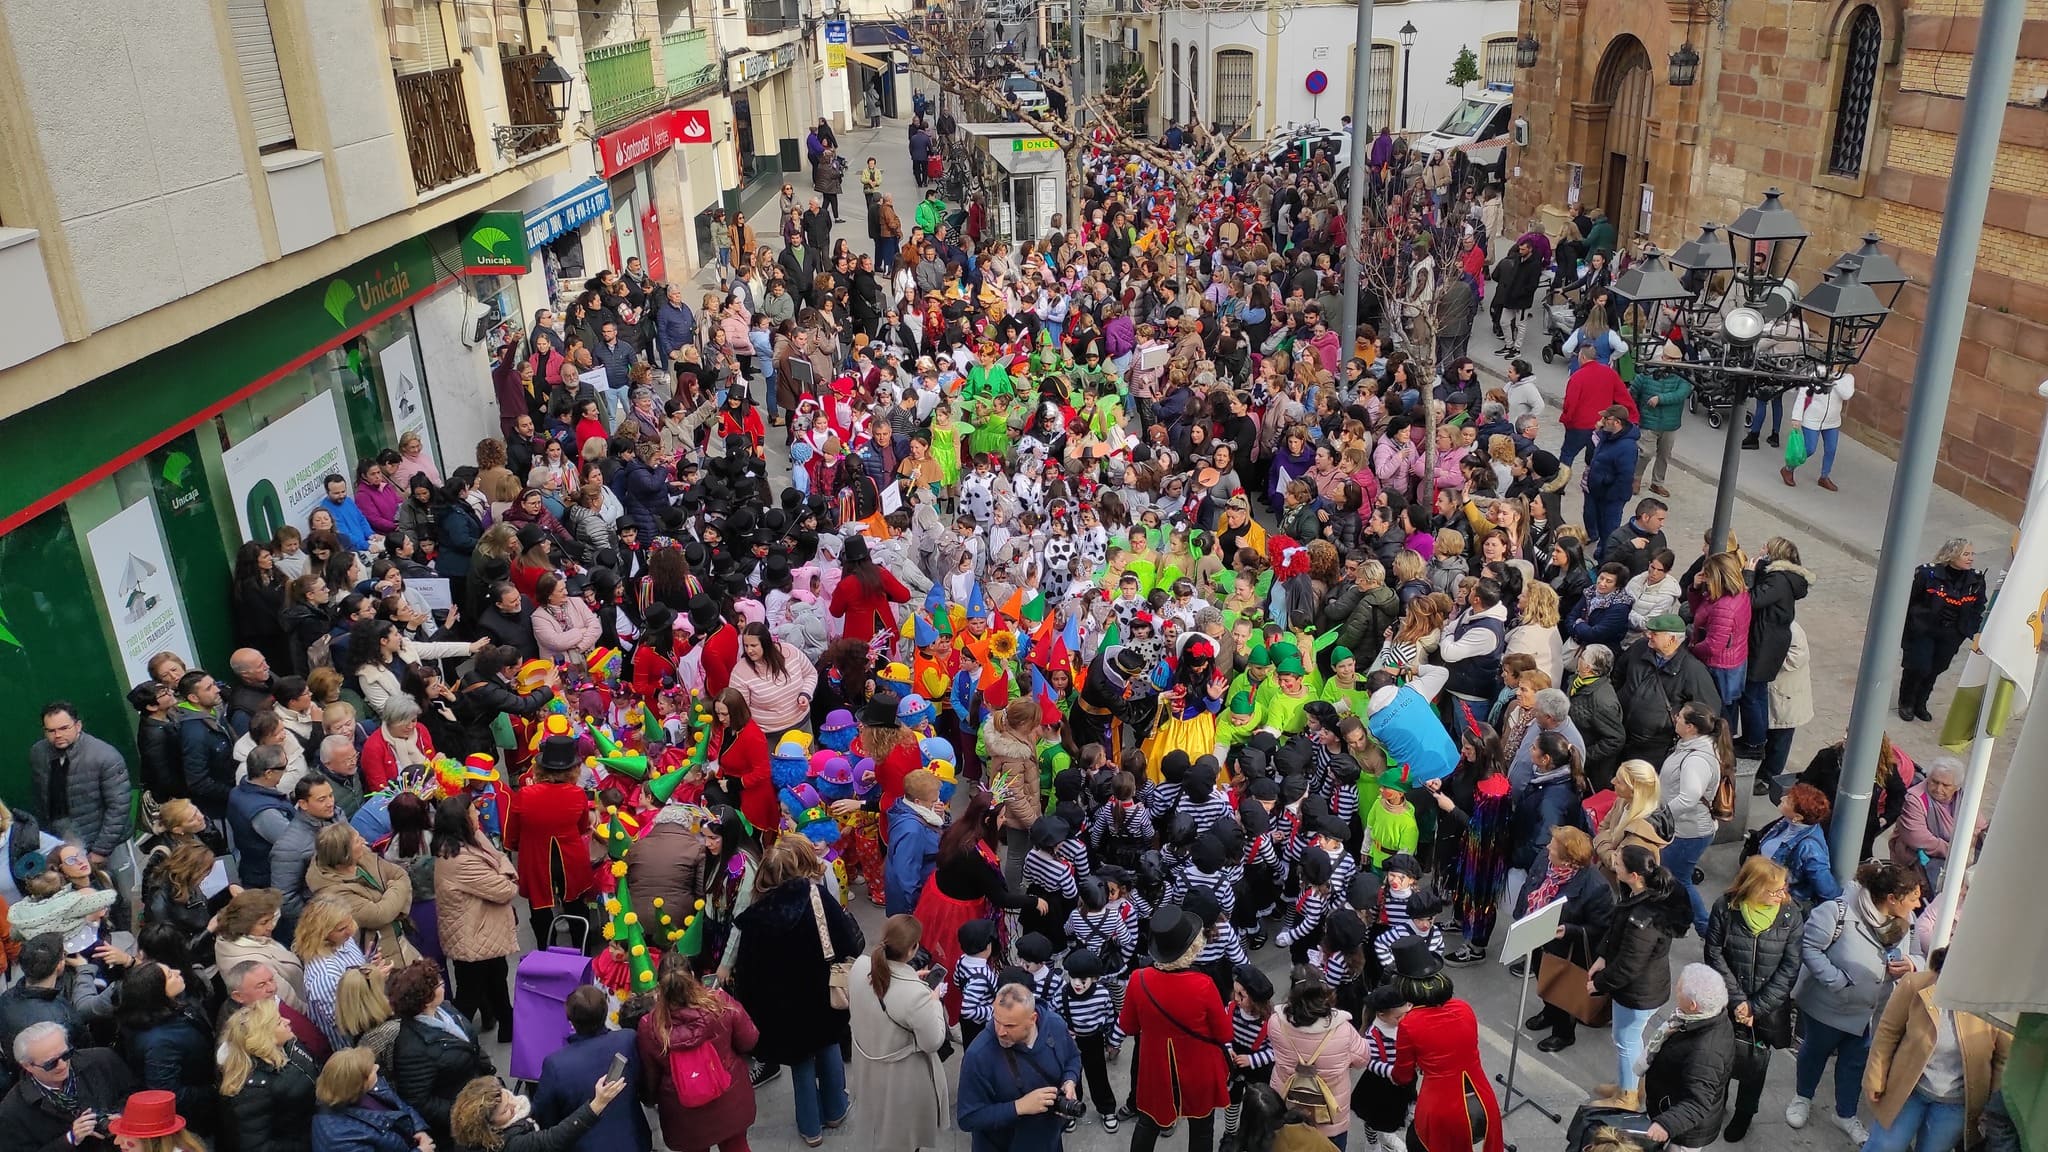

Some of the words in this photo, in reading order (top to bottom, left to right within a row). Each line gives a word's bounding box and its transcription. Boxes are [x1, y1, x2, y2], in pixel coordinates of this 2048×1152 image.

[623, 134, 650, 162] Santander
[654, 130, 669, 149] Agentes
[477, 254, 512, 266] Unicaja
[357, 262, 410, 311] Unicaja
[172, 485, 200, 510] Unicaja
[289, 491, 303, 508] PLAN
[302, 482, 315, 498] CERO
[146, 618, 176, 645] TRANQUILIDAD
